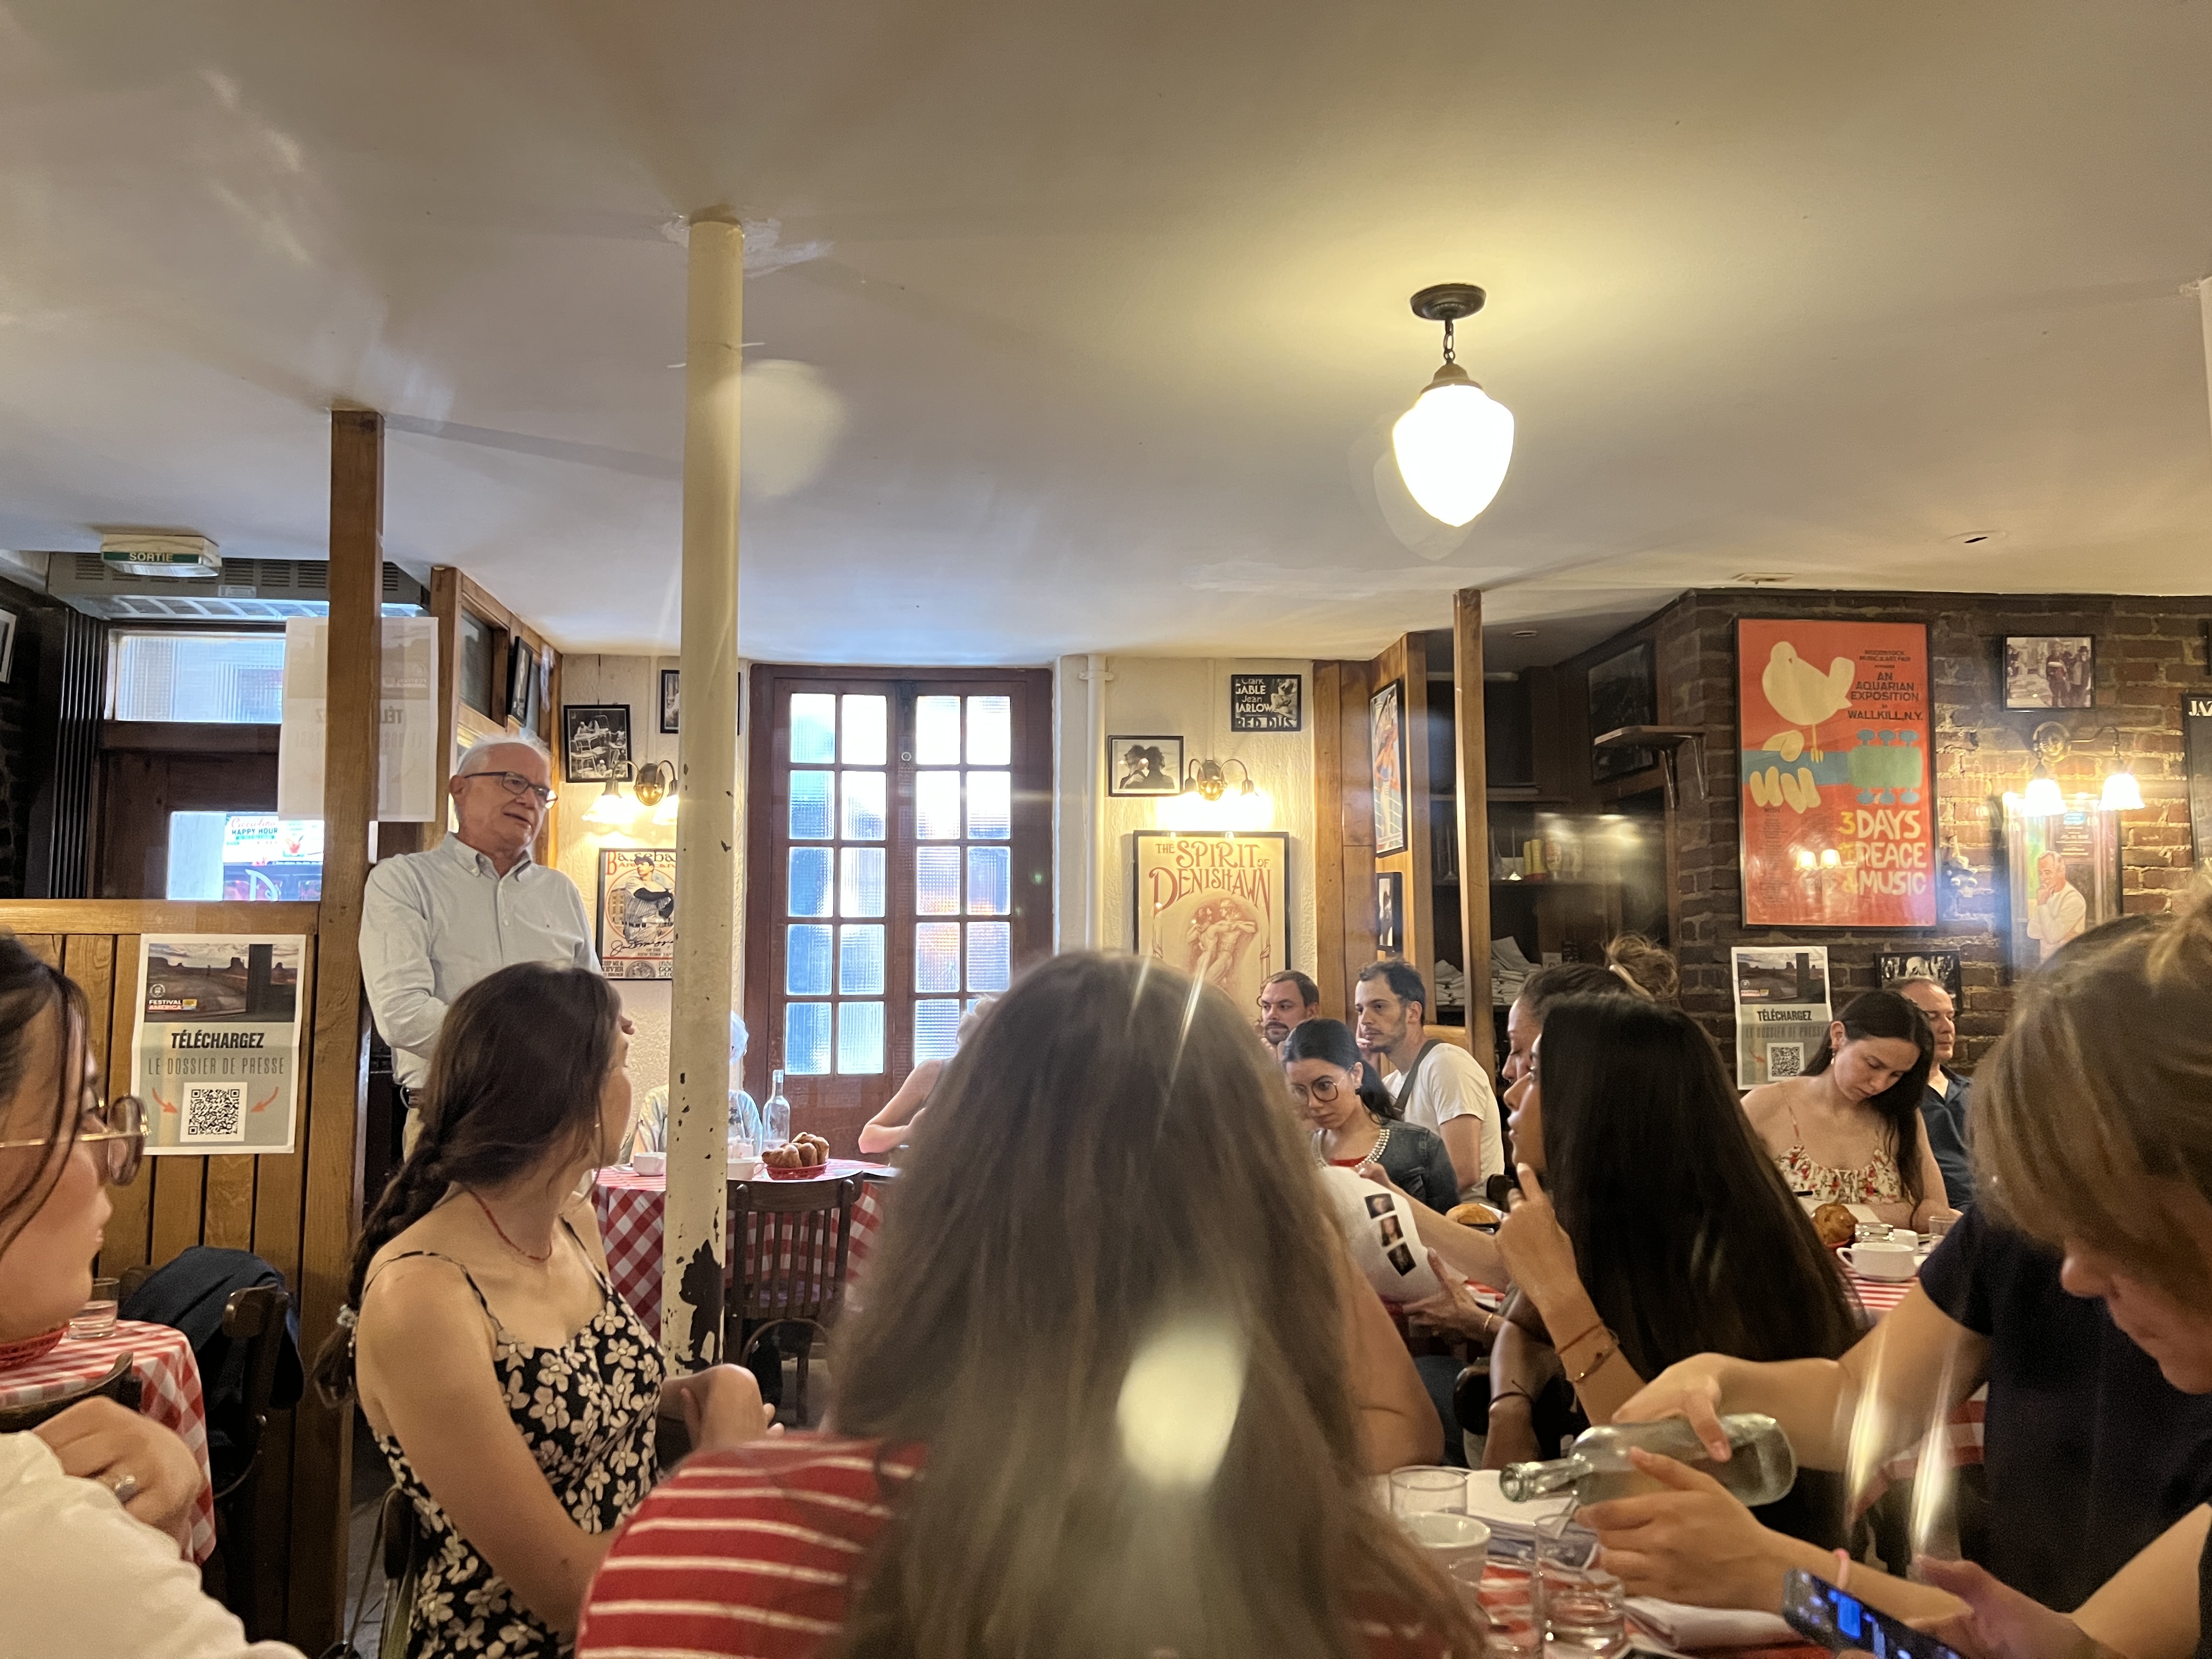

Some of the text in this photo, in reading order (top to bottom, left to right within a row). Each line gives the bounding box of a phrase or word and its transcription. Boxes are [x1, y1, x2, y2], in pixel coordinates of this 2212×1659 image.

[129, 552, 173, 562] SORTIE
[1877, 672, 1893, 681] AN
[1855, 681, 1914, 691] AQUARIAN
[1850, 691, 1919, 701] EXPOSITION
[2189, 701, 2212, 716] JAZ
[1267, 717, 1296, 728] DUS
[1839, 811, 1856, 835] 3
[1857, 809, 1921, 840] DAYS
[1155, 840, 1271, 868] THE SPIRIT OF
[1855, 842, 1927, 869] PEACE
[1858, 870, 1927, 896] MUSIC
[1149, 867, 1272, 924] DENISHAWN
[1757, 1008, 1812, 1022] TÉLÉCHARGEZ
[171, 1029, 265, 1048] TÉLÉCHARGEZ
[1757, 1026, 1785, 1038] DOSSIER
[148, 1057, 284, 1075] LE DOSSIER DE PRESSE
